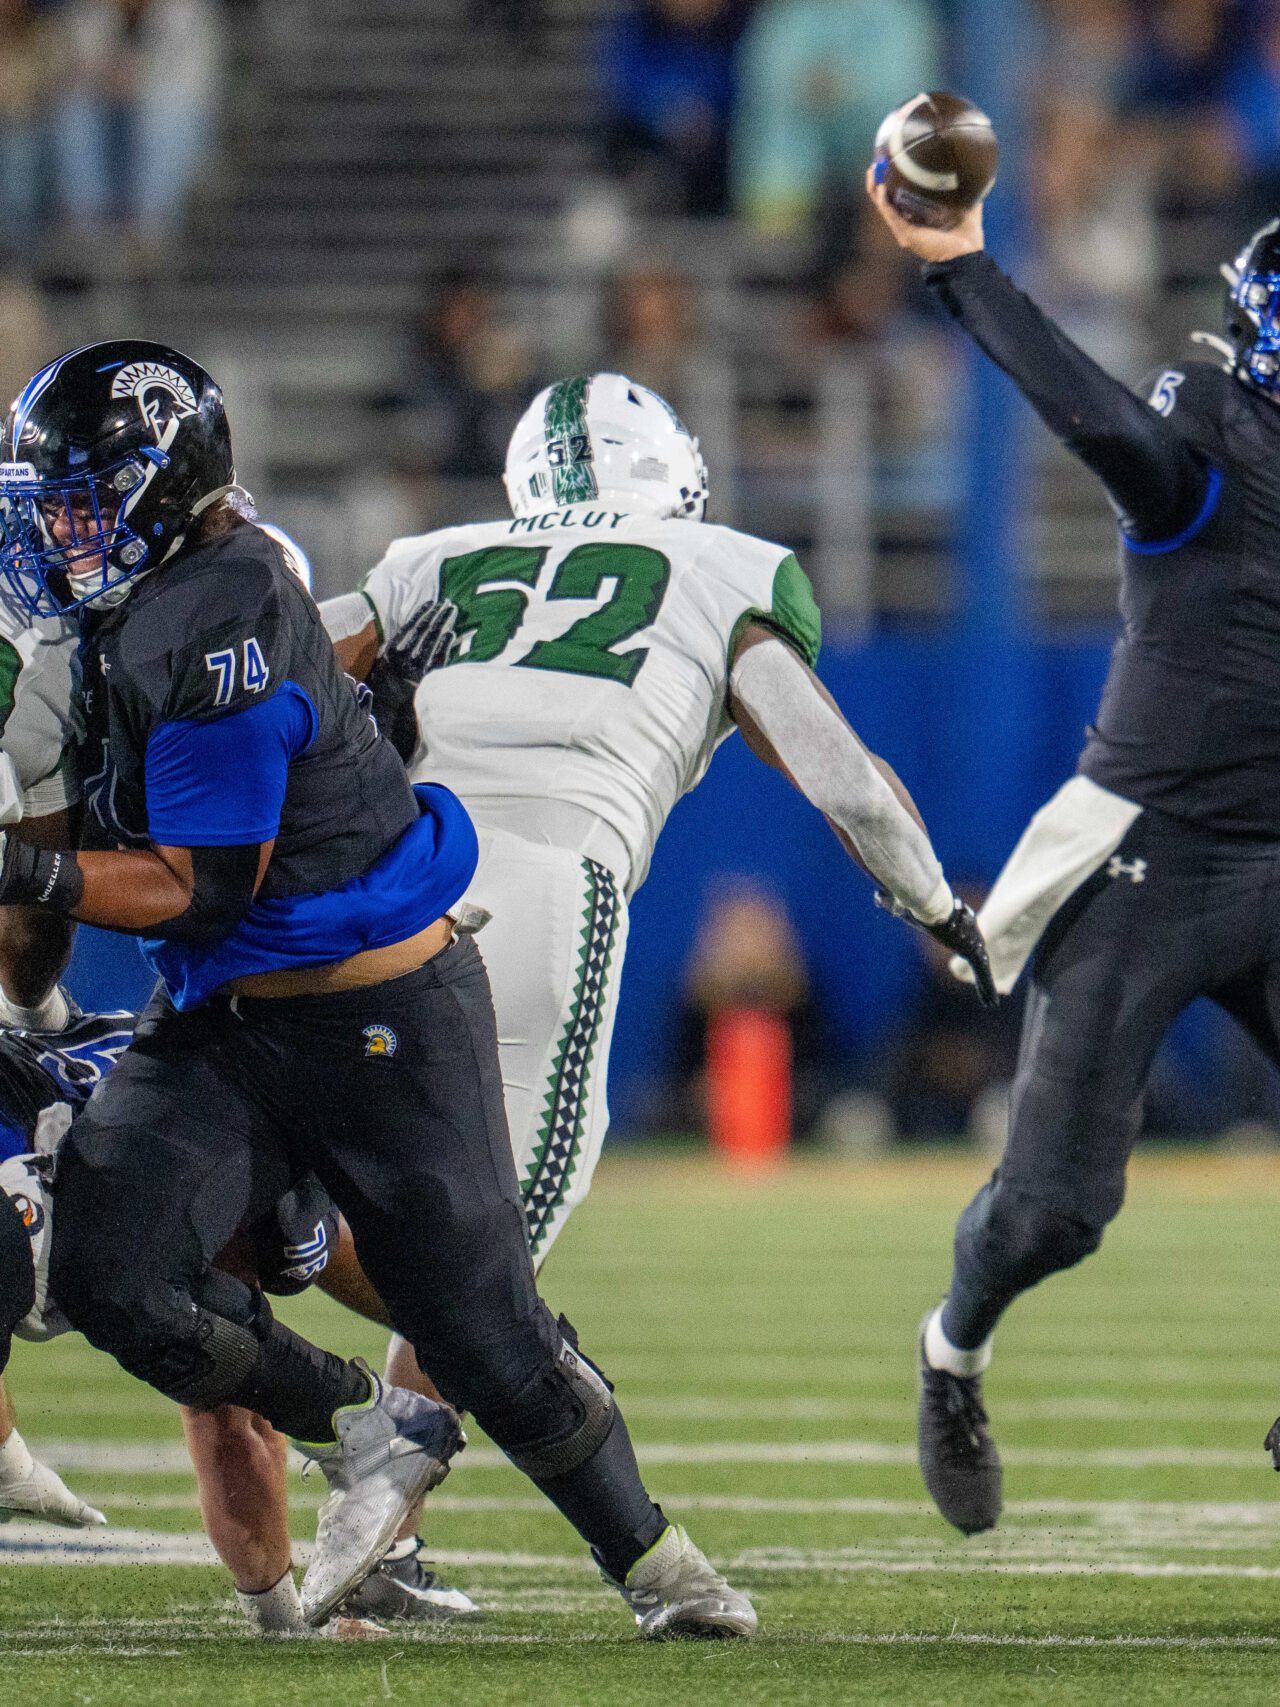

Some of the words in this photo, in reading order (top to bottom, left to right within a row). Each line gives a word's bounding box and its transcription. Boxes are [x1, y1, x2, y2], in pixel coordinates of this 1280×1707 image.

[1148, 370, 1185, 417] 5
[547, 434, 594, 469] 52
[439, 542, 671, 689] 52
[205, 637, 270, 706] 74
[41, 853, 61, 900] MUELLER
